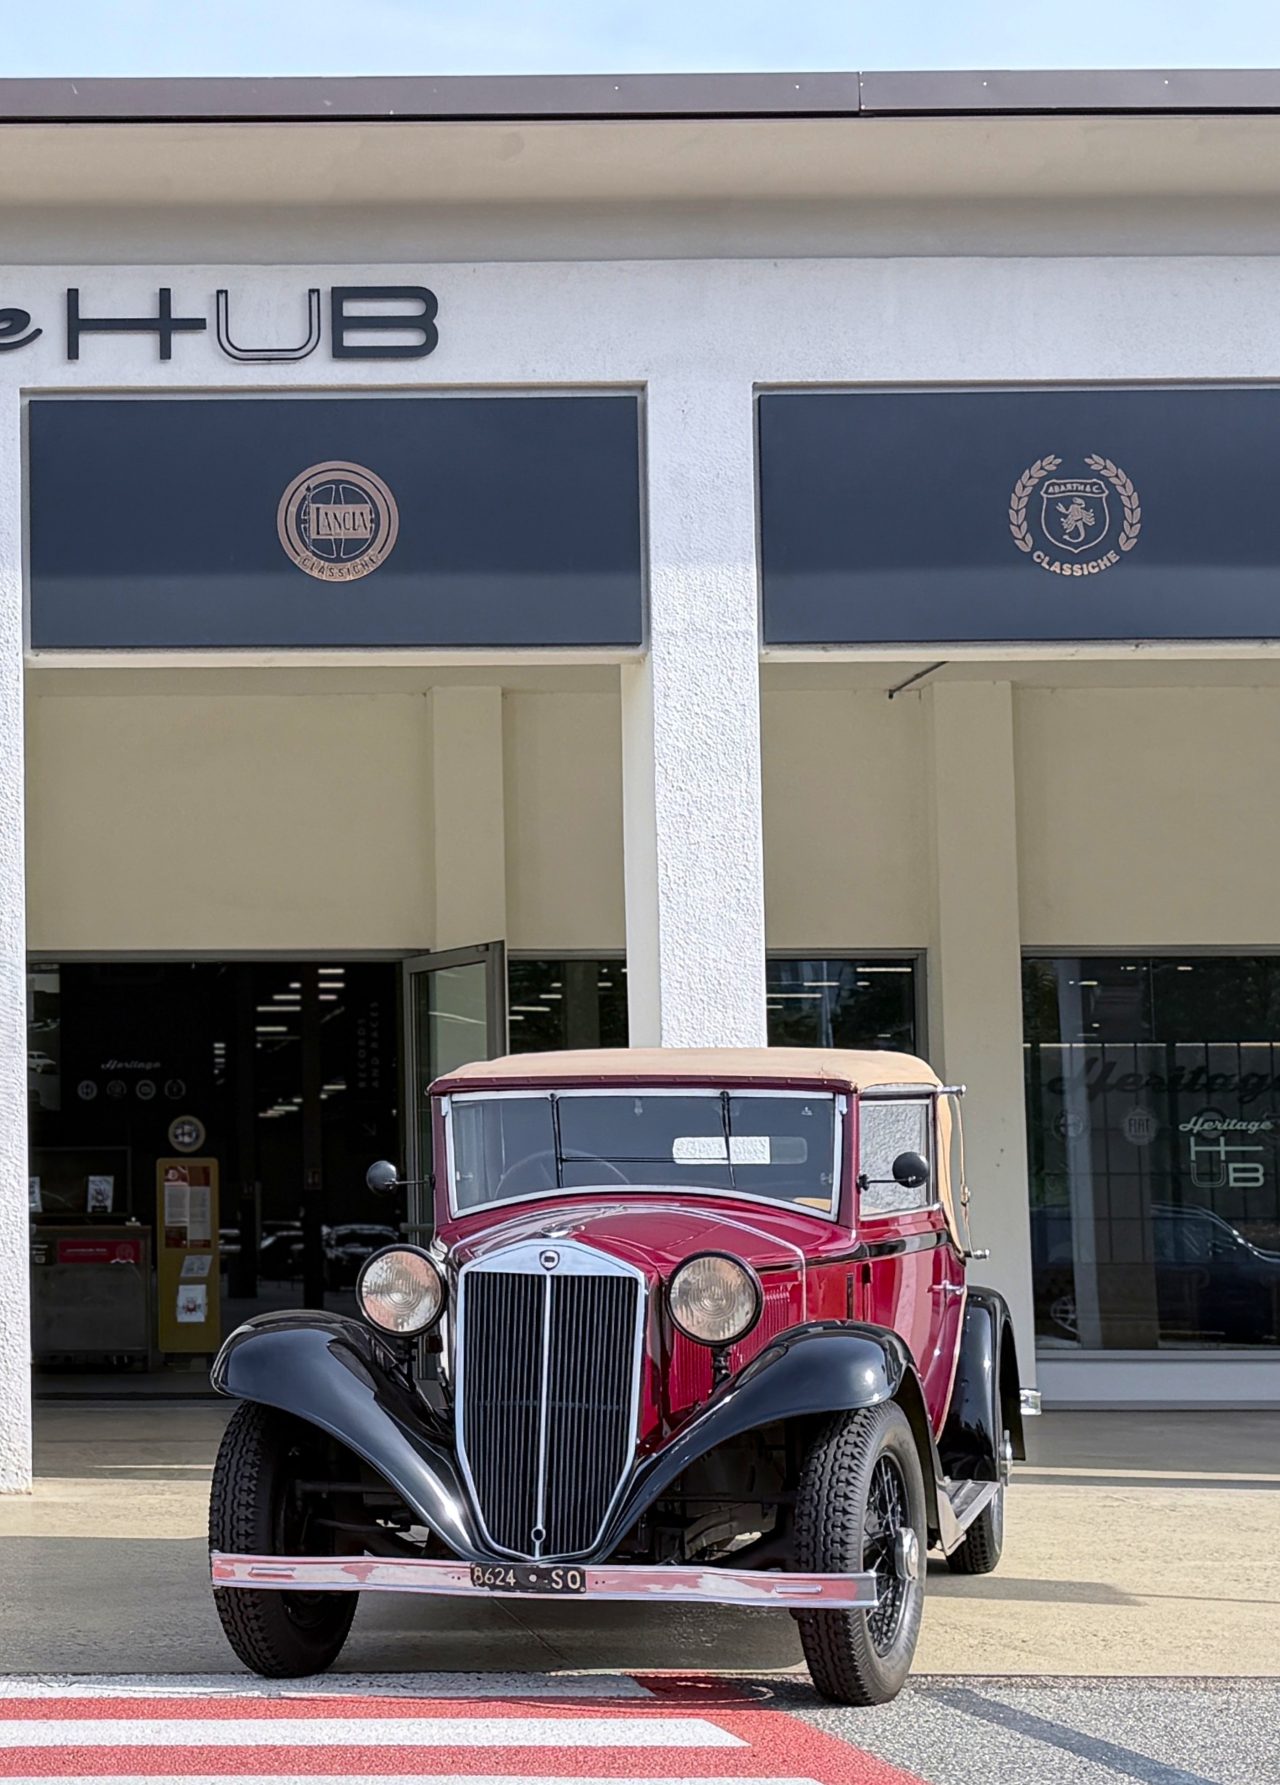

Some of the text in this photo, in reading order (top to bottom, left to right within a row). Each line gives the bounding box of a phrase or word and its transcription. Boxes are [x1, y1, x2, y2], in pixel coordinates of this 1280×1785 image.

[67, 285, 439, 363] HUB
[316, 506, 368, 536] LANCIA
[302, 555, 377, 577] CLASSICHE
[1032, 550, 1120, 577] CLASSICHE
[1179, 1115, 1274, 1135] Heritage
[473, 1567, 516, 1587] 8624
